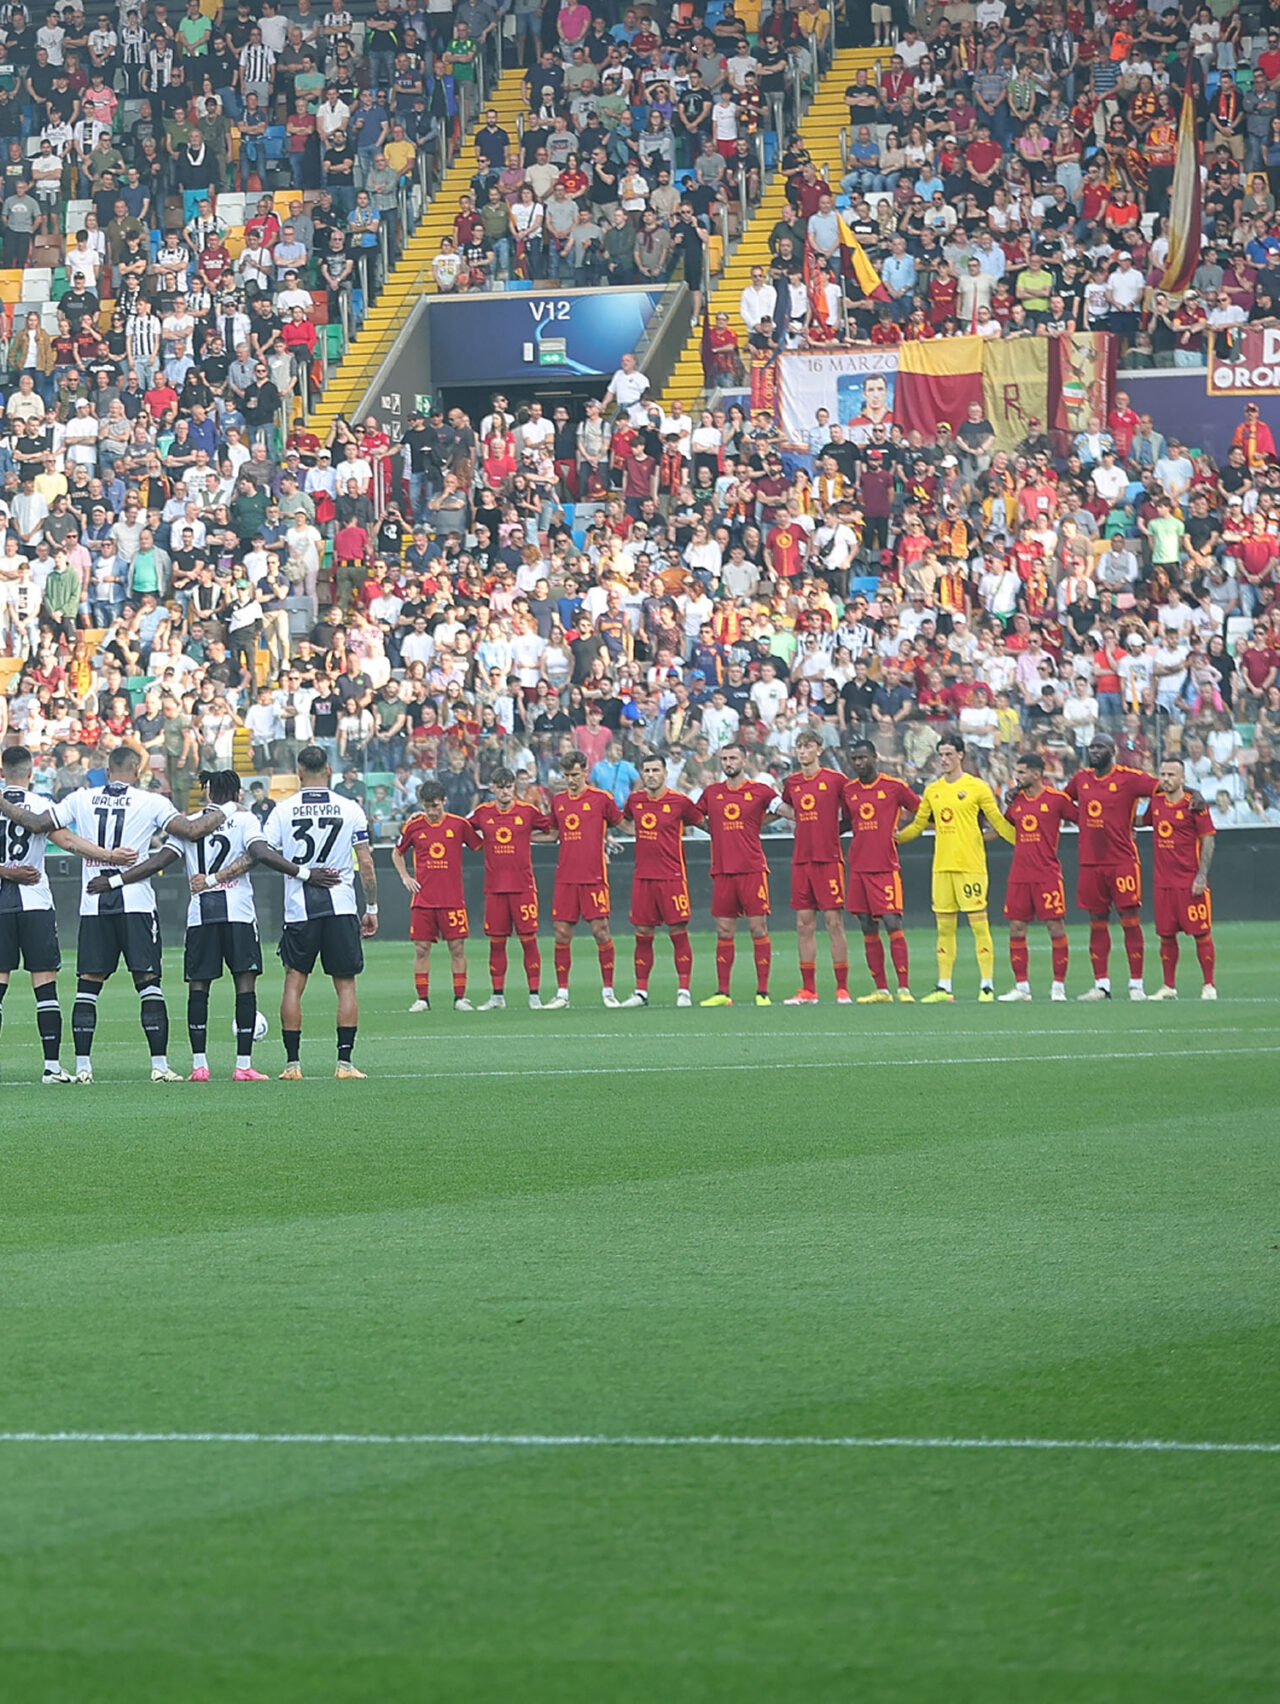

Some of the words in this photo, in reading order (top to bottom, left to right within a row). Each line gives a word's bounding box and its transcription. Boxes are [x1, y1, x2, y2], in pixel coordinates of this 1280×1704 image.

[529, 301, 570, 321] V12
[807, 360, 824, 373] 16
[829, 354, 898, 371] MARZO
[292, 804, 341, 817] PEREYRA
[94, 807, 126, 850] 11
[291, 817, 344, 865] 37
[196, 833, 231, 876] 12
[757, 885, 766, 900] 4
[829, 880, 839, 895] 3
[884, 885, 894, 901] 5
[963, 882, 982, 899] 99
[1116, 875, 1136, 893] 90
[591, 890, 606, 907] 14
[672, 894, 689, 912] 16
[1042, 890, 1061, 909] 22
[448, 910, 465, 927] 35
[520, 904, 538, 921] 59
[1187, 903, 1208, 921] 69
